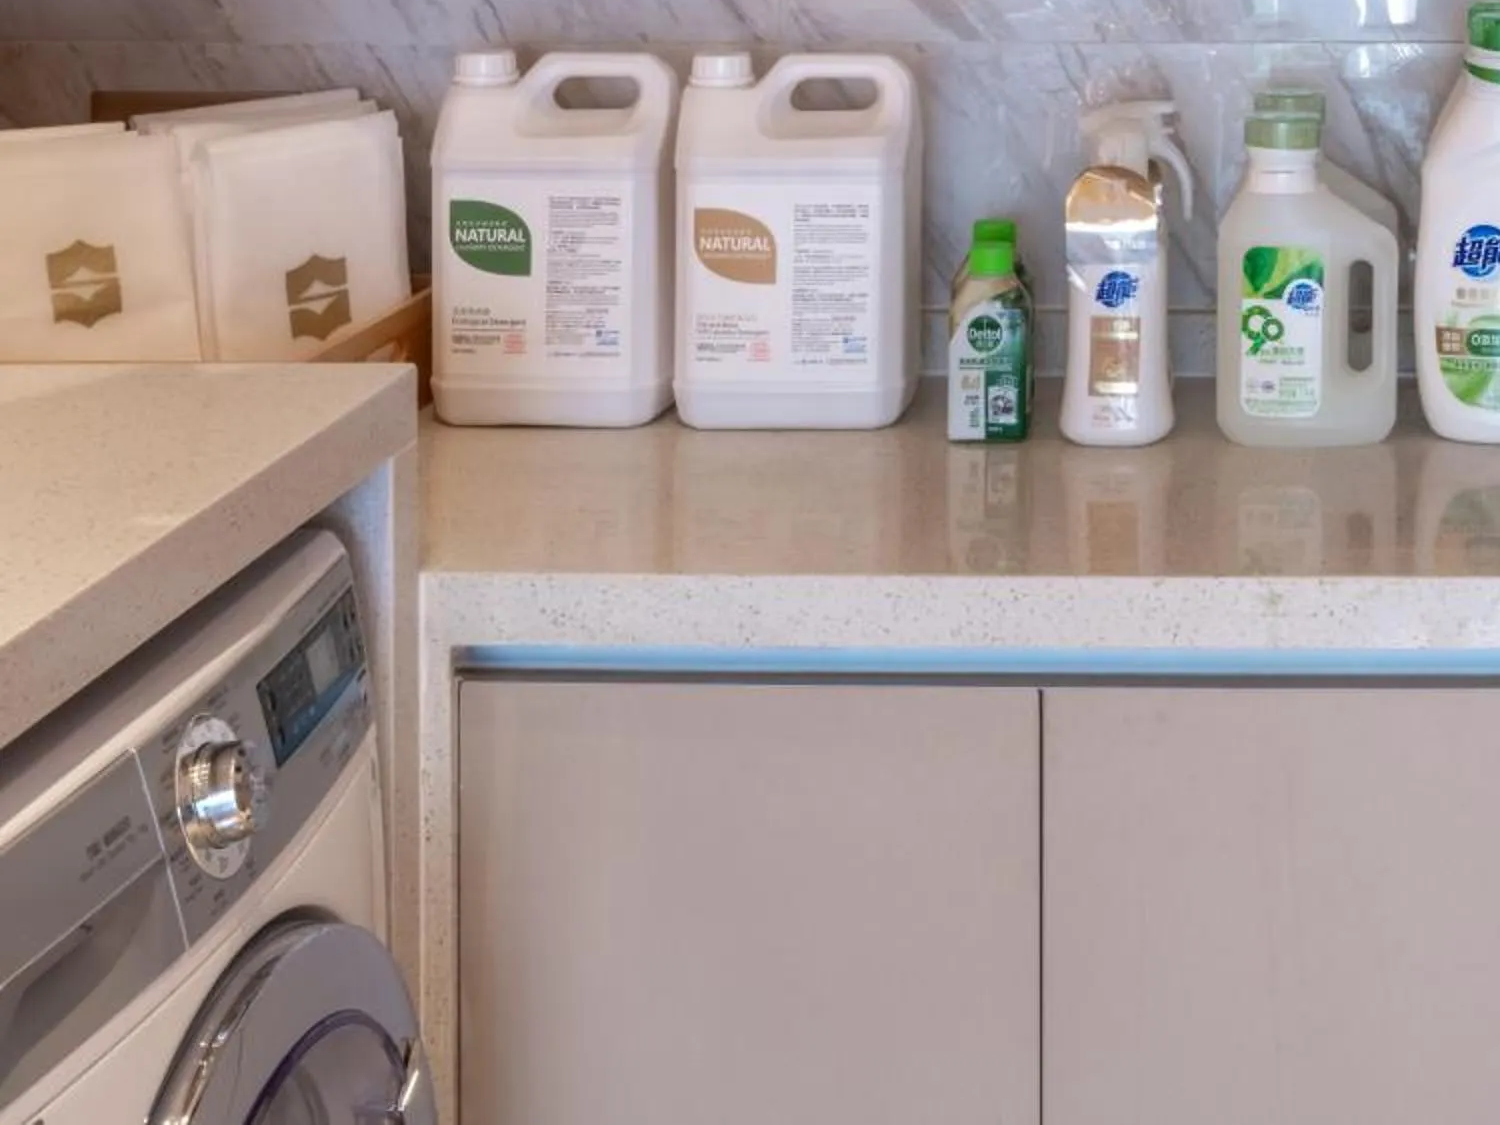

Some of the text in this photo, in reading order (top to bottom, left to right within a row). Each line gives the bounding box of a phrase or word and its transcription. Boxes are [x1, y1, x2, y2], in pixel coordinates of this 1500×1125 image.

[455, 227, 526, 243] NATURAL
[700, 236, 771, 252] NATURAL
[969, 326, 1001, 340] Dettol
